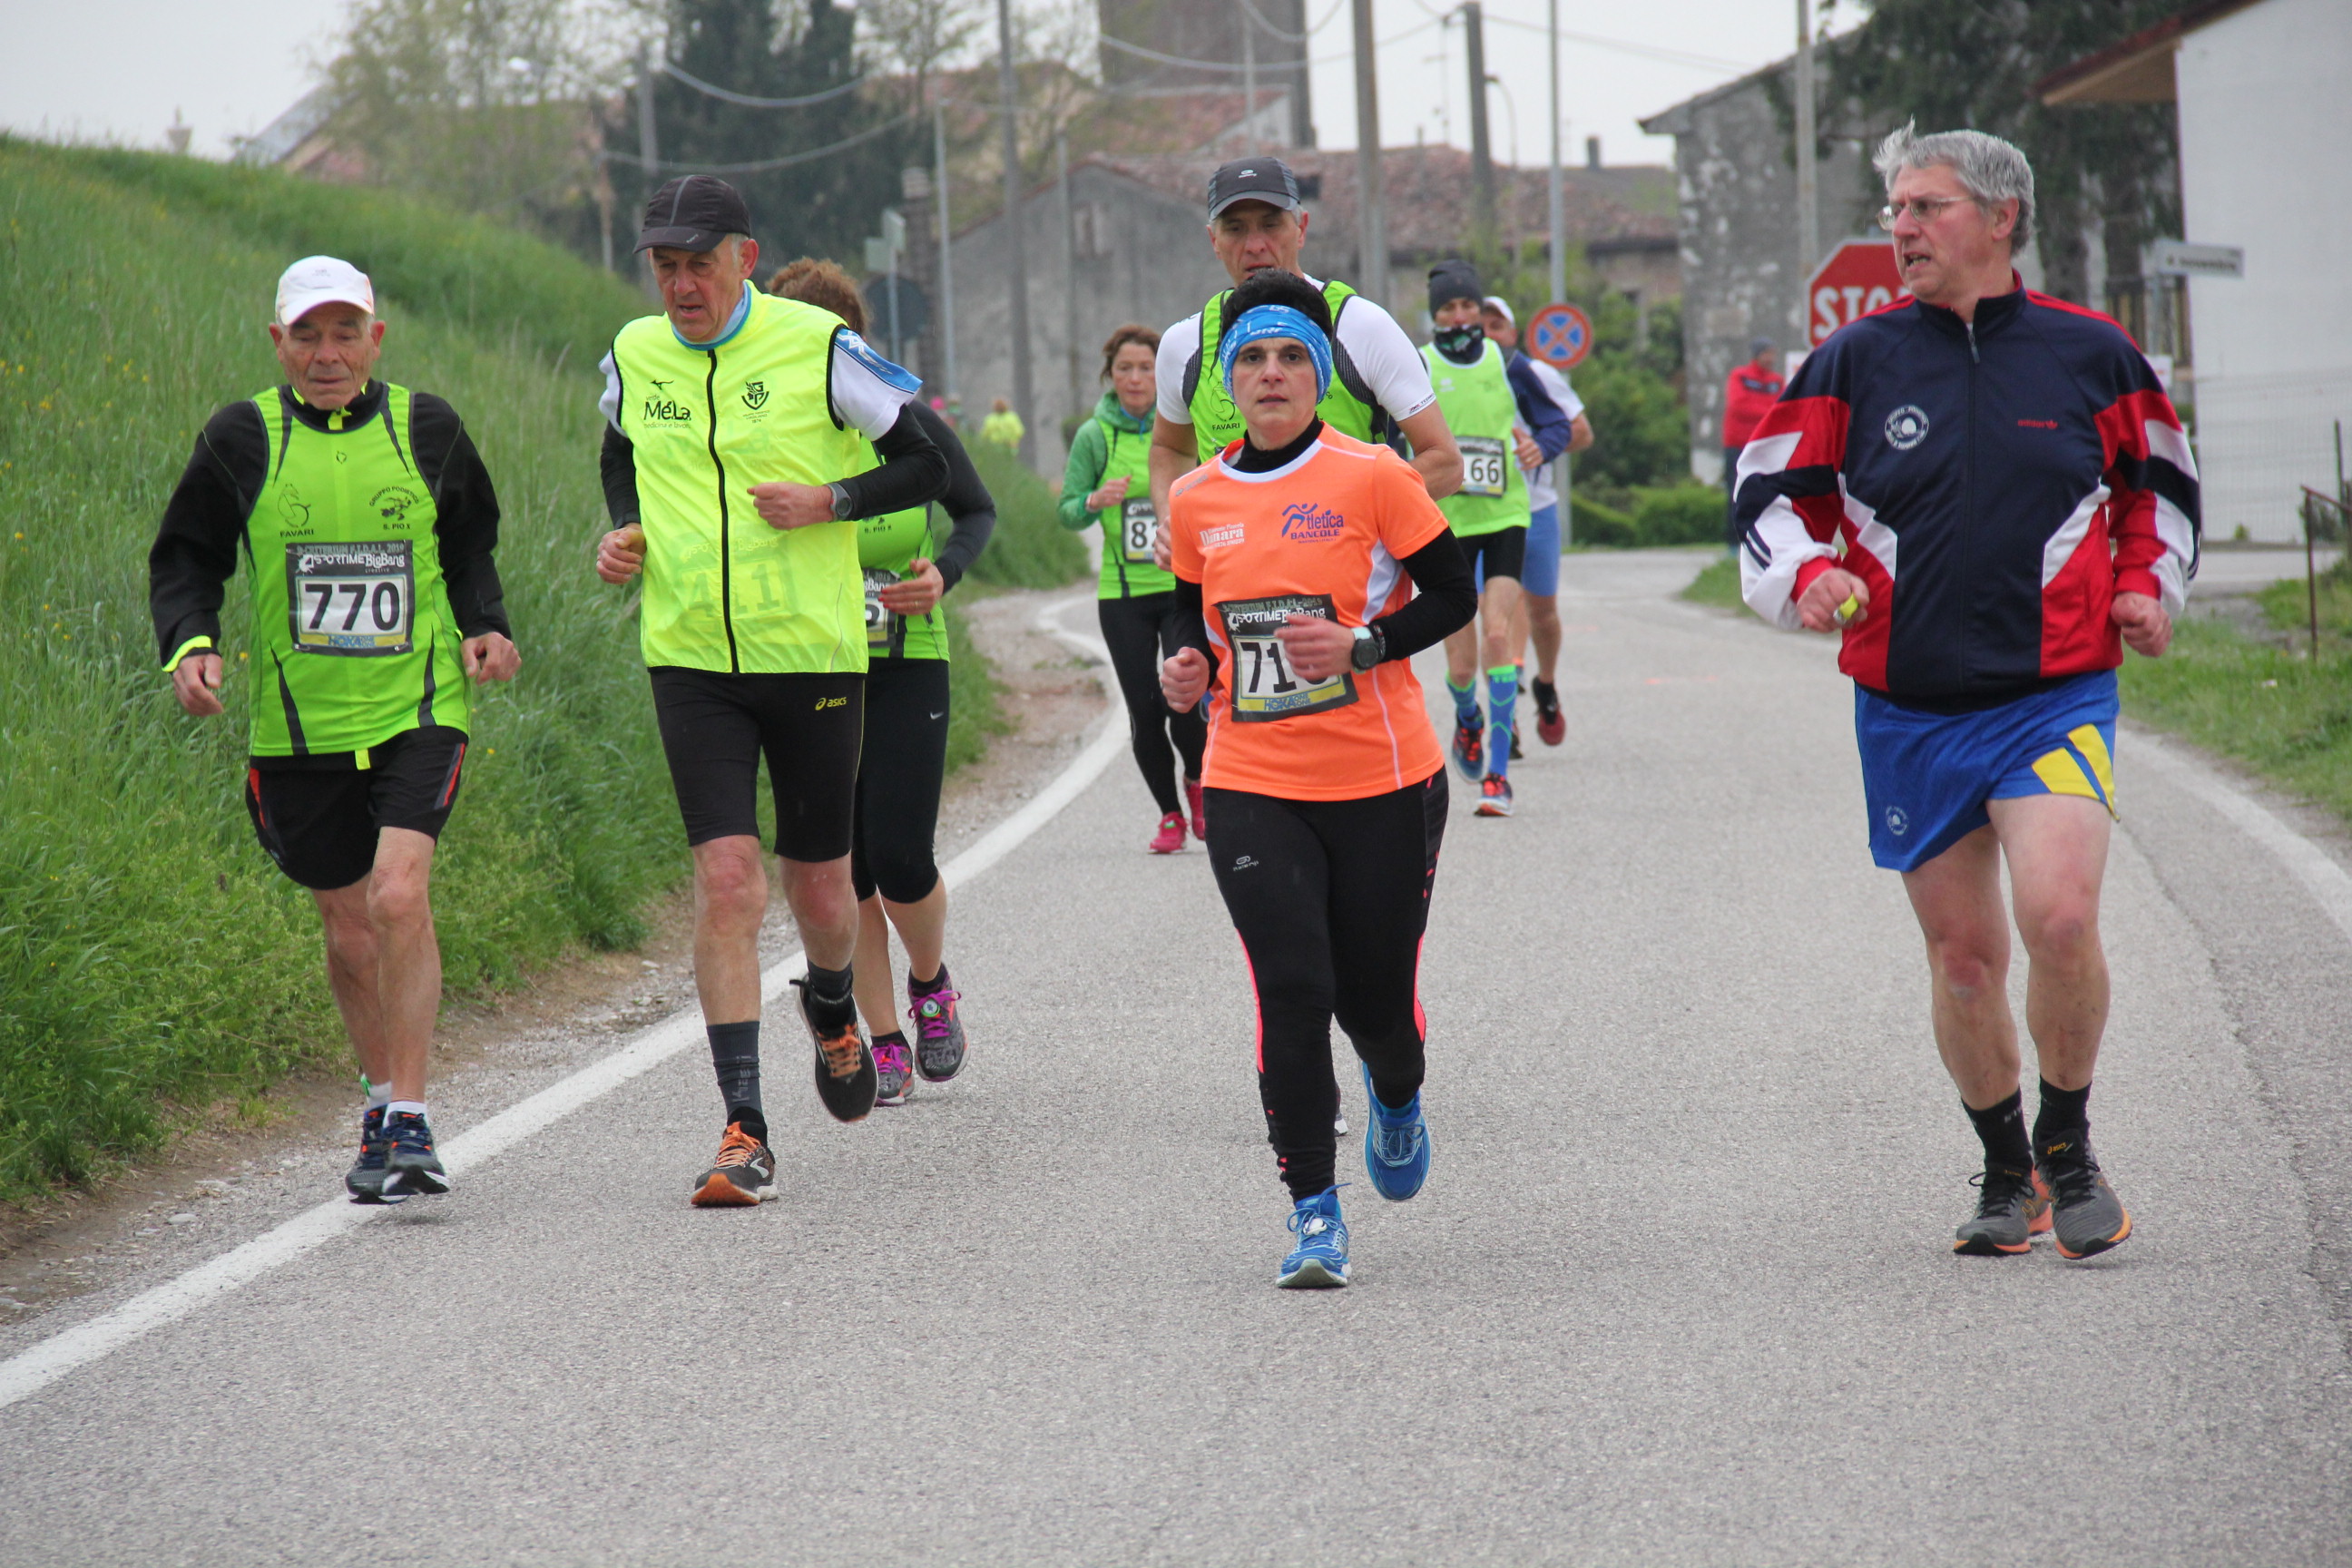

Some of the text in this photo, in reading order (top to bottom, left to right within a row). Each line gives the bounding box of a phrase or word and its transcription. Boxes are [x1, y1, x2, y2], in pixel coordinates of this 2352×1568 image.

[1463, 458, 1499, 484] 66
[279, 528, 314, 537] FAVARI
[1290, 529, 1340, 540] BANCOLE
[304, 582, 401, 632] 770
[1240, 641, 1330, 694] 71
